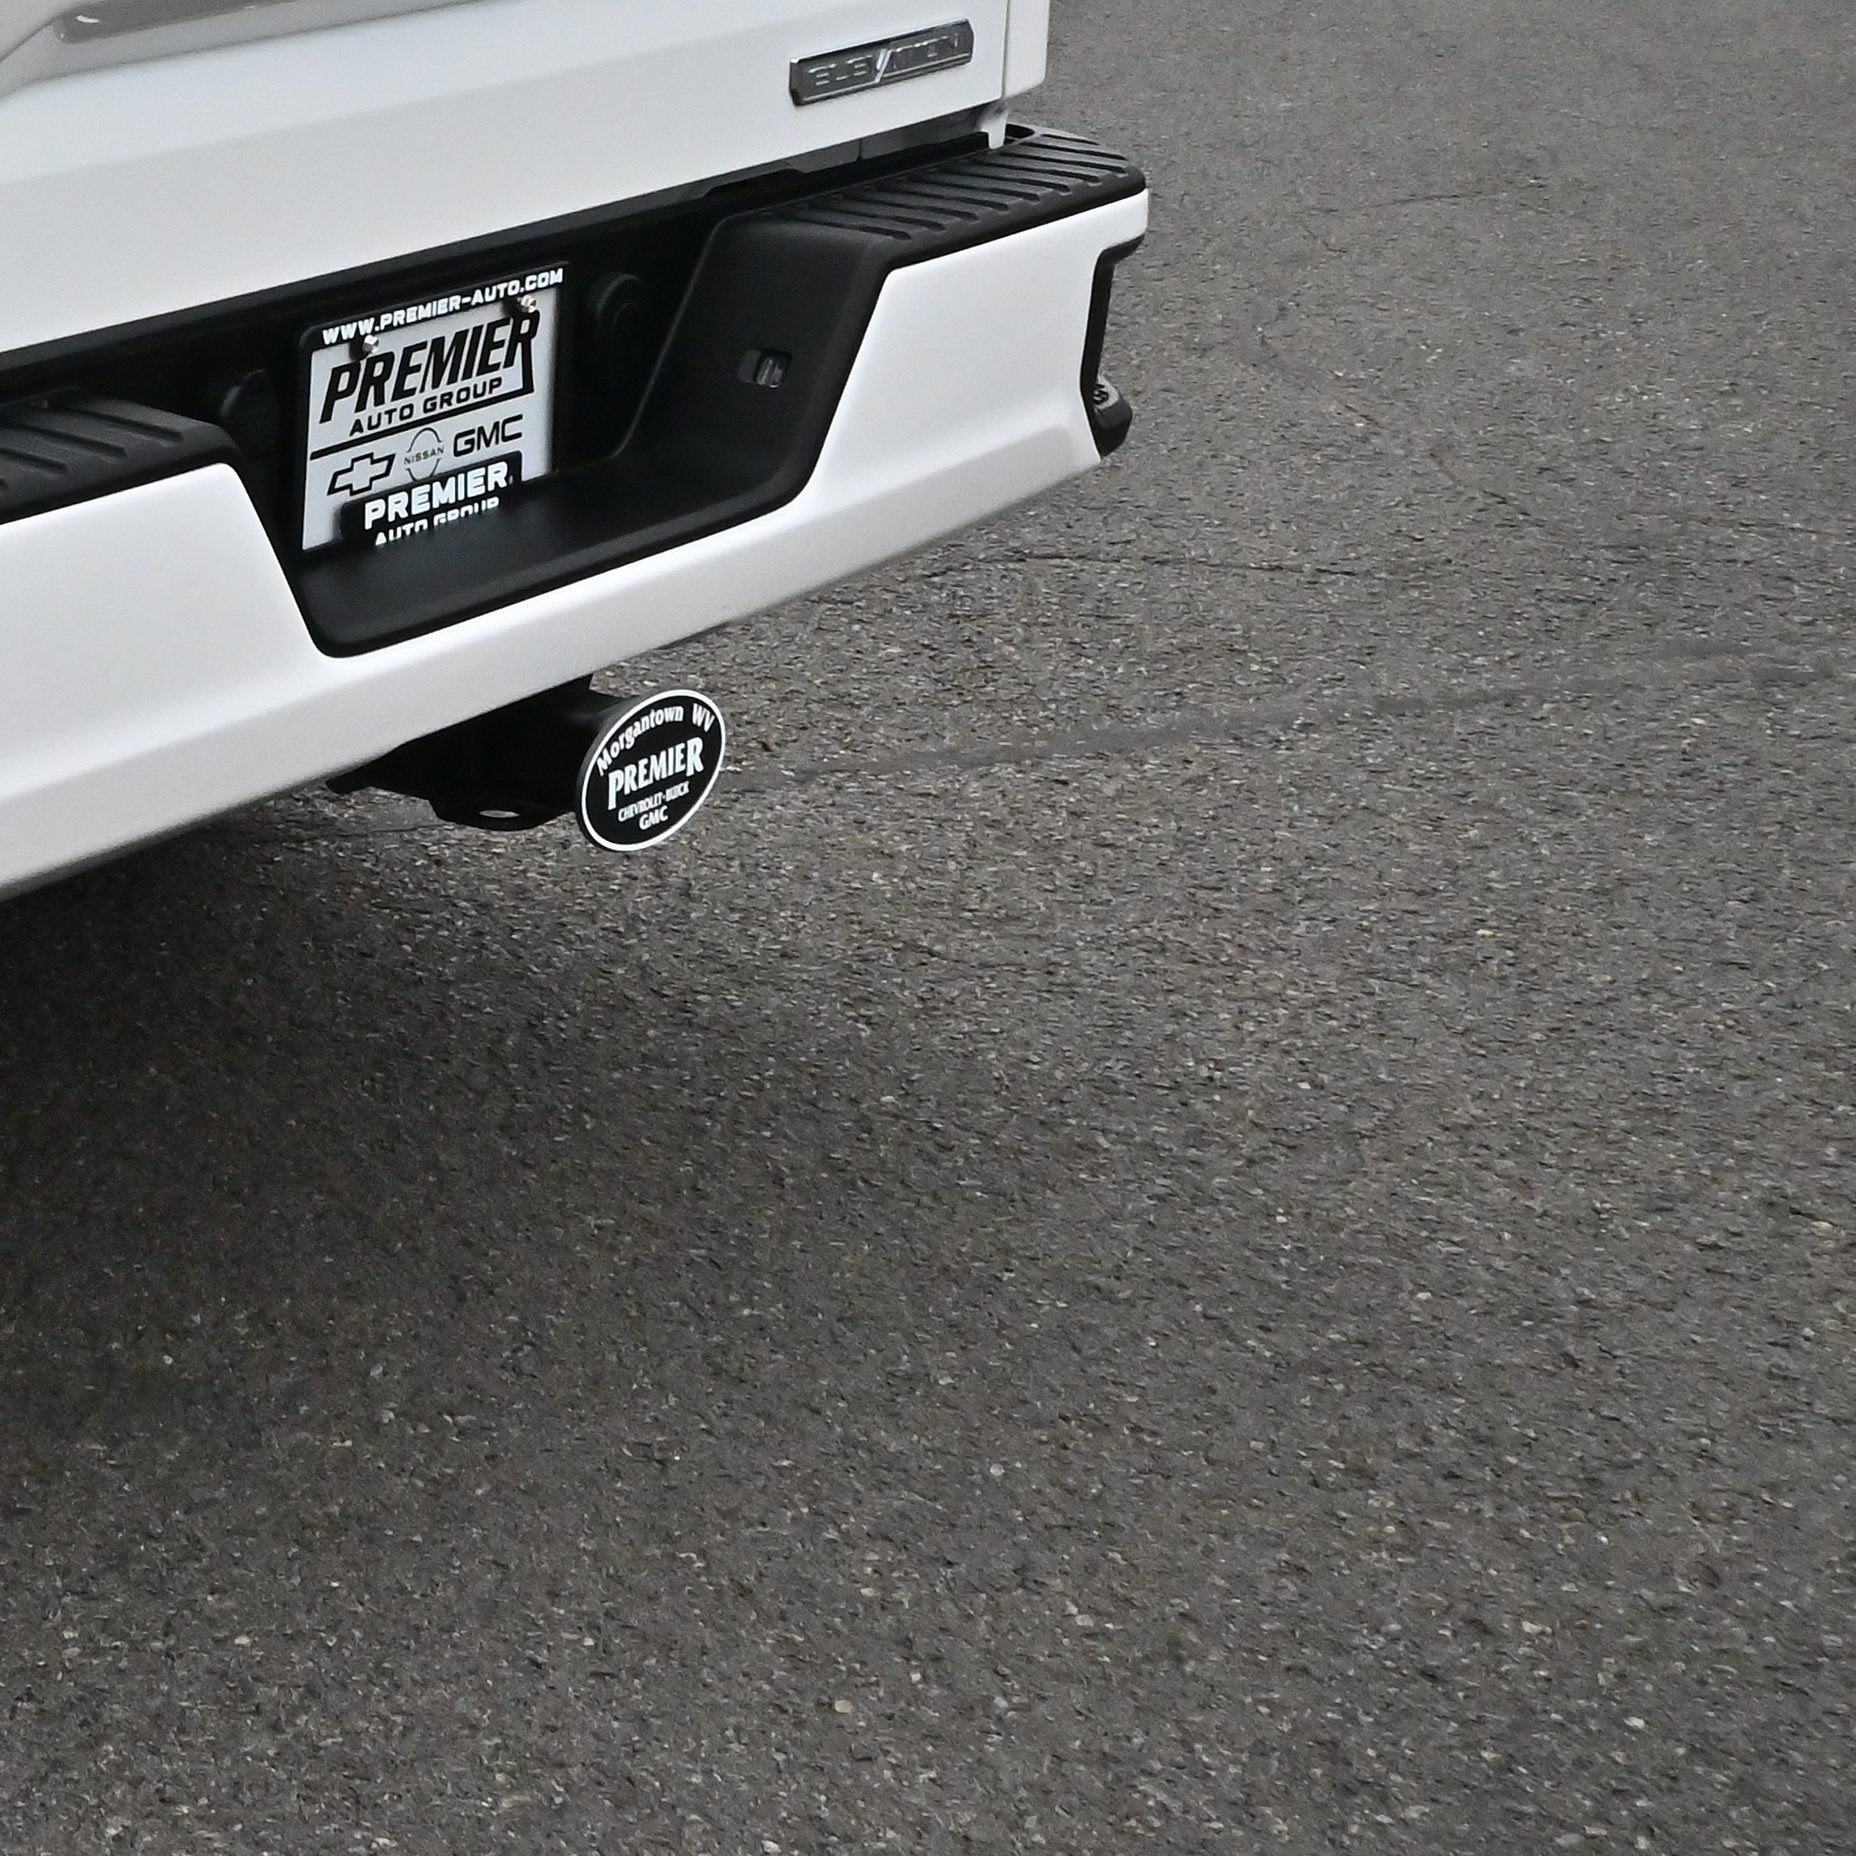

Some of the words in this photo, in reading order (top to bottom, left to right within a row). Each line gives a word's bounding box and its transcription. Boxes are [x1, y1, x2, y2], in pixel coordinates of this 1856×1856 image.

[322, 267, 564, 345] WWW.PREMIER-AUTO.COM
[319, 310, 541, 425] PREMIER
[349, 403, 415, 437] AUTO
[422, 376, 503, 413] GROUP
[452, 414, 524, 457] GMC
[403, 445, 445, 465] NISSAN
[364, 460, 509, 530] PREMIER
[595, 705, 684, 777] Morgantown
[691, 702, 716, 733] WV
[607, 736, 705, 811] PREMIER
[639, 805, 669, 831] GMC
